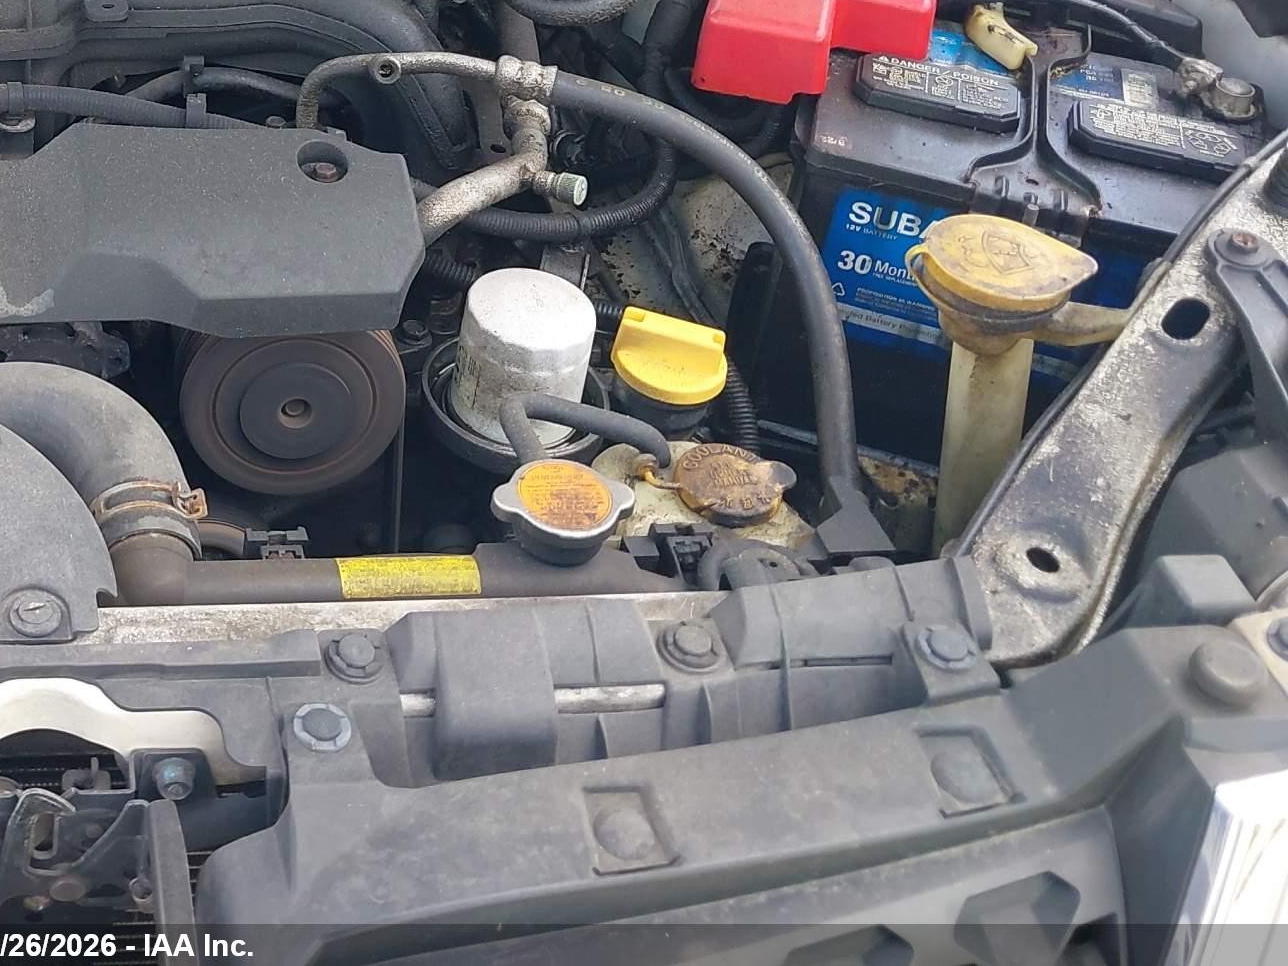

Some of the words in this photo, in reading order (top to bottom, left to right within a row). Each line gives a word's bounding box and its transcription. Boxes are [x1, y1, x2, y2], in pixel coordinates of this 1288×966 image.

[890, 56, 941, 74] DANGER
[953, 71, 999, 87] POISON
[846, 223, 861, 233] 12V
[862, 227, 898, 241] BATTERY
[837, 249, 873, 275] 30
